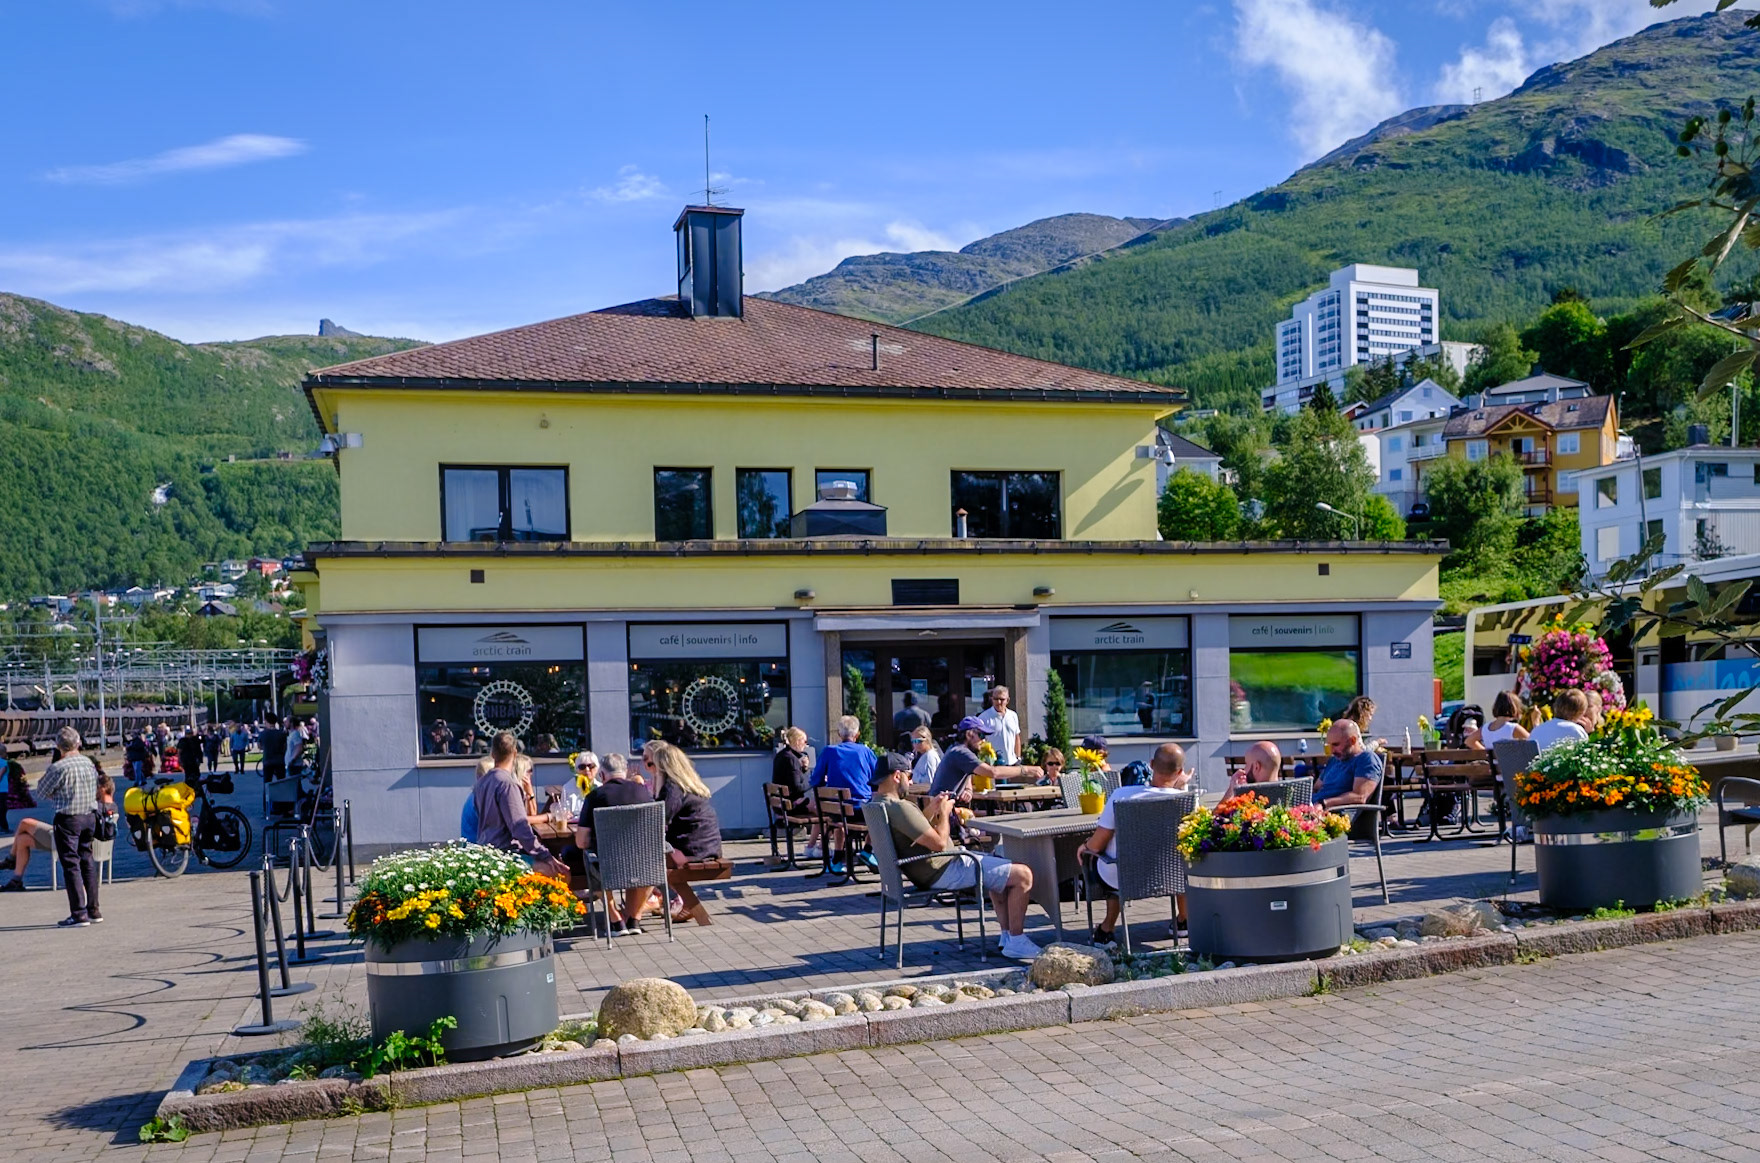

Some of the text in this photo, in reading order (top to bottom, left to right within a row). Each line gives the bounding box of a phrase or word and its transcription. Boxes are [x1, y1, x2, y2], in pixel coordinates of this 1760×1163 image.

[1251, 625, 1335, 635] café souvenirs info
[659, 634, 758, 645] café souvenirs info
[1094, 634, 1145, 645] arctic train
[472, 645, 532, 656] arctic train
